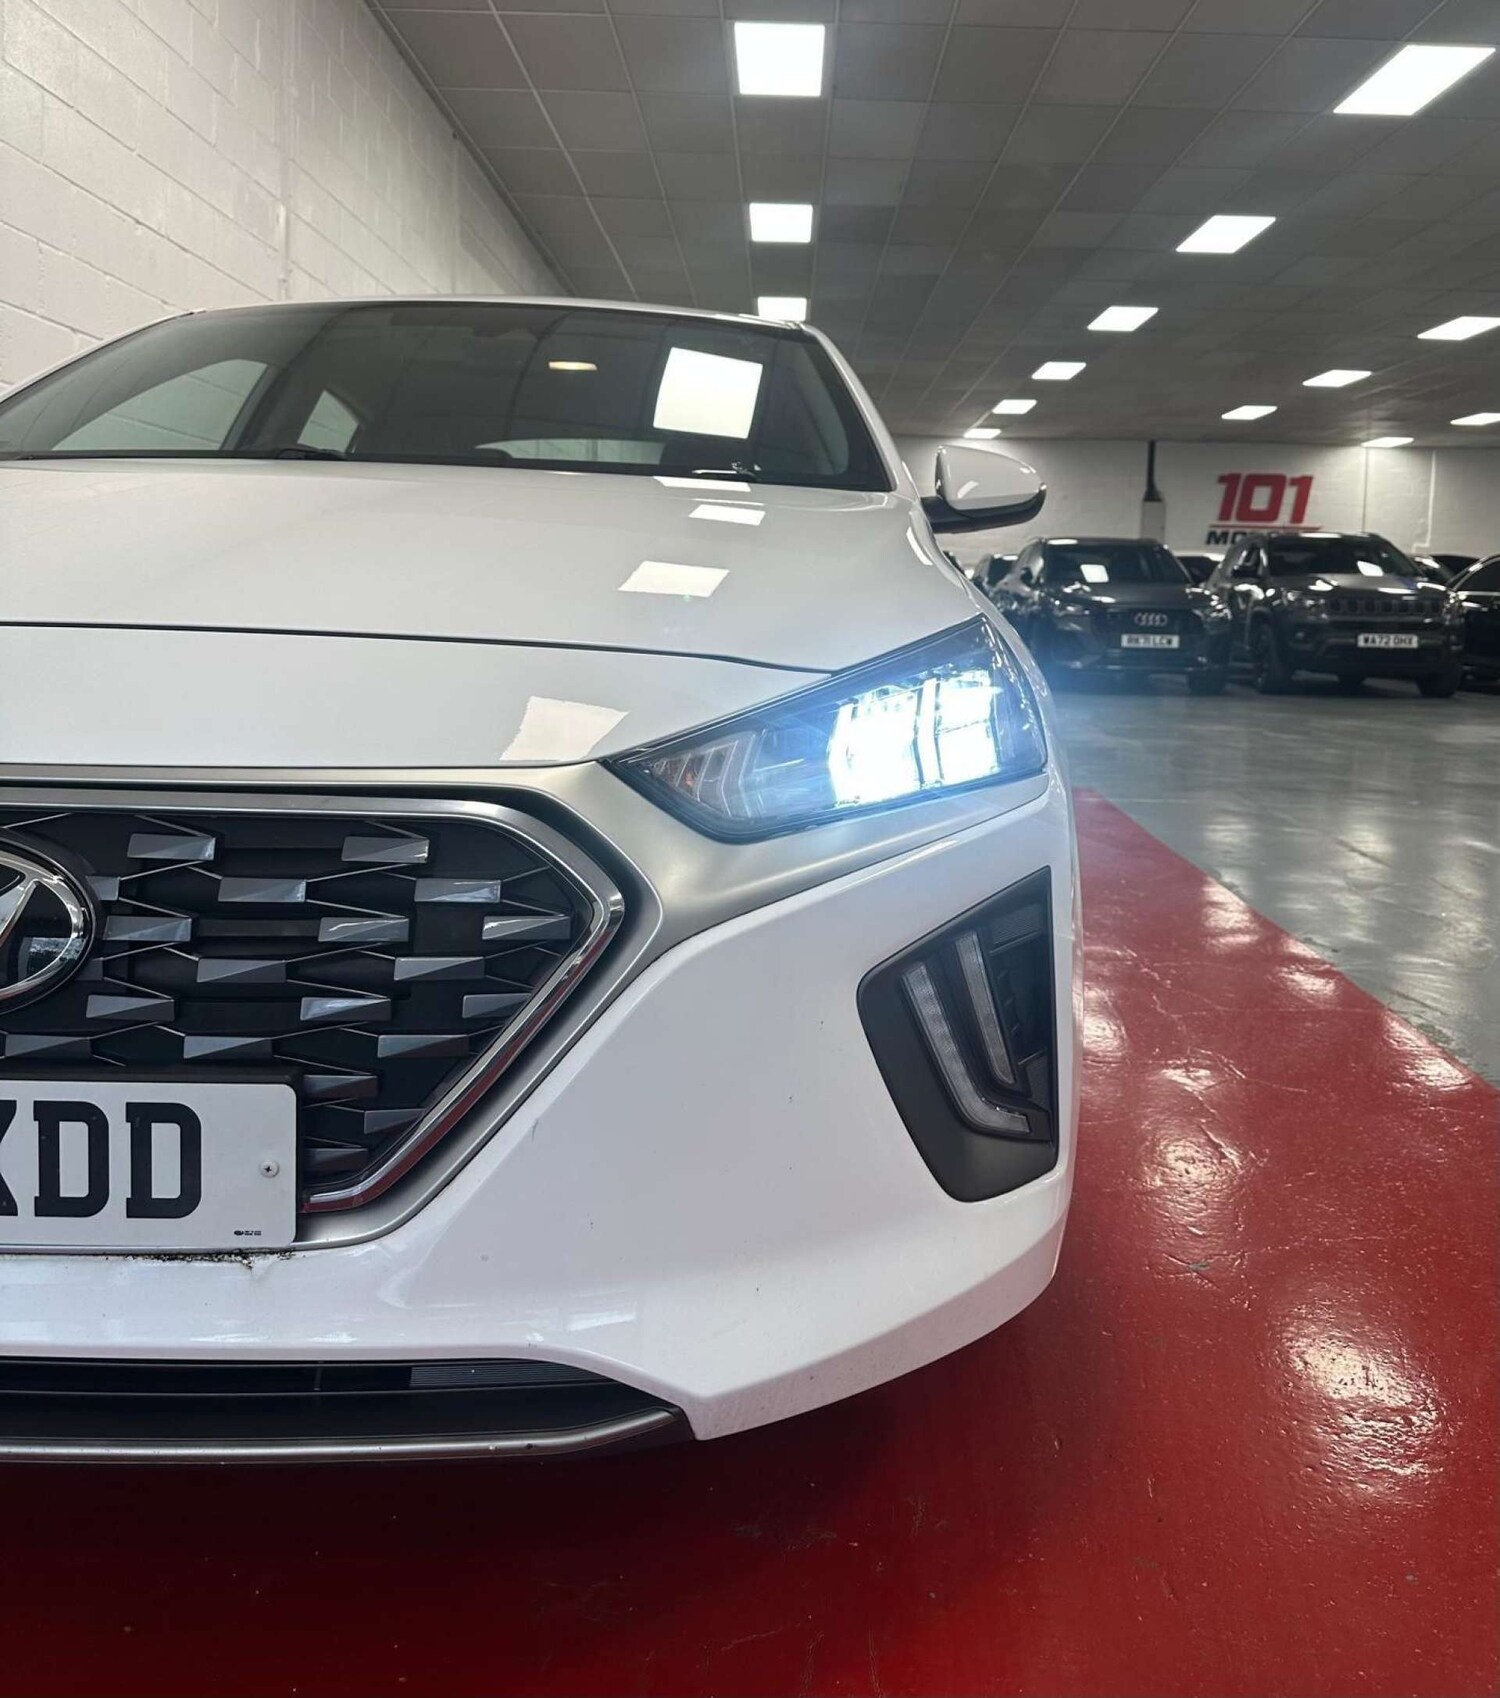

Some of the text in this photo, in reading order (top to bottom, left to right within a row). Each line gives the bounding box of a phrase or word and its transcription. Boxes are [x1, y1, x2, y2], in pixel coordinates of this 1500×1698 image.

[1217, 473, 1313, 523] 101
[1363, 634, 1391, 646] WA72
[0, 1100, 202, 1218] DD
